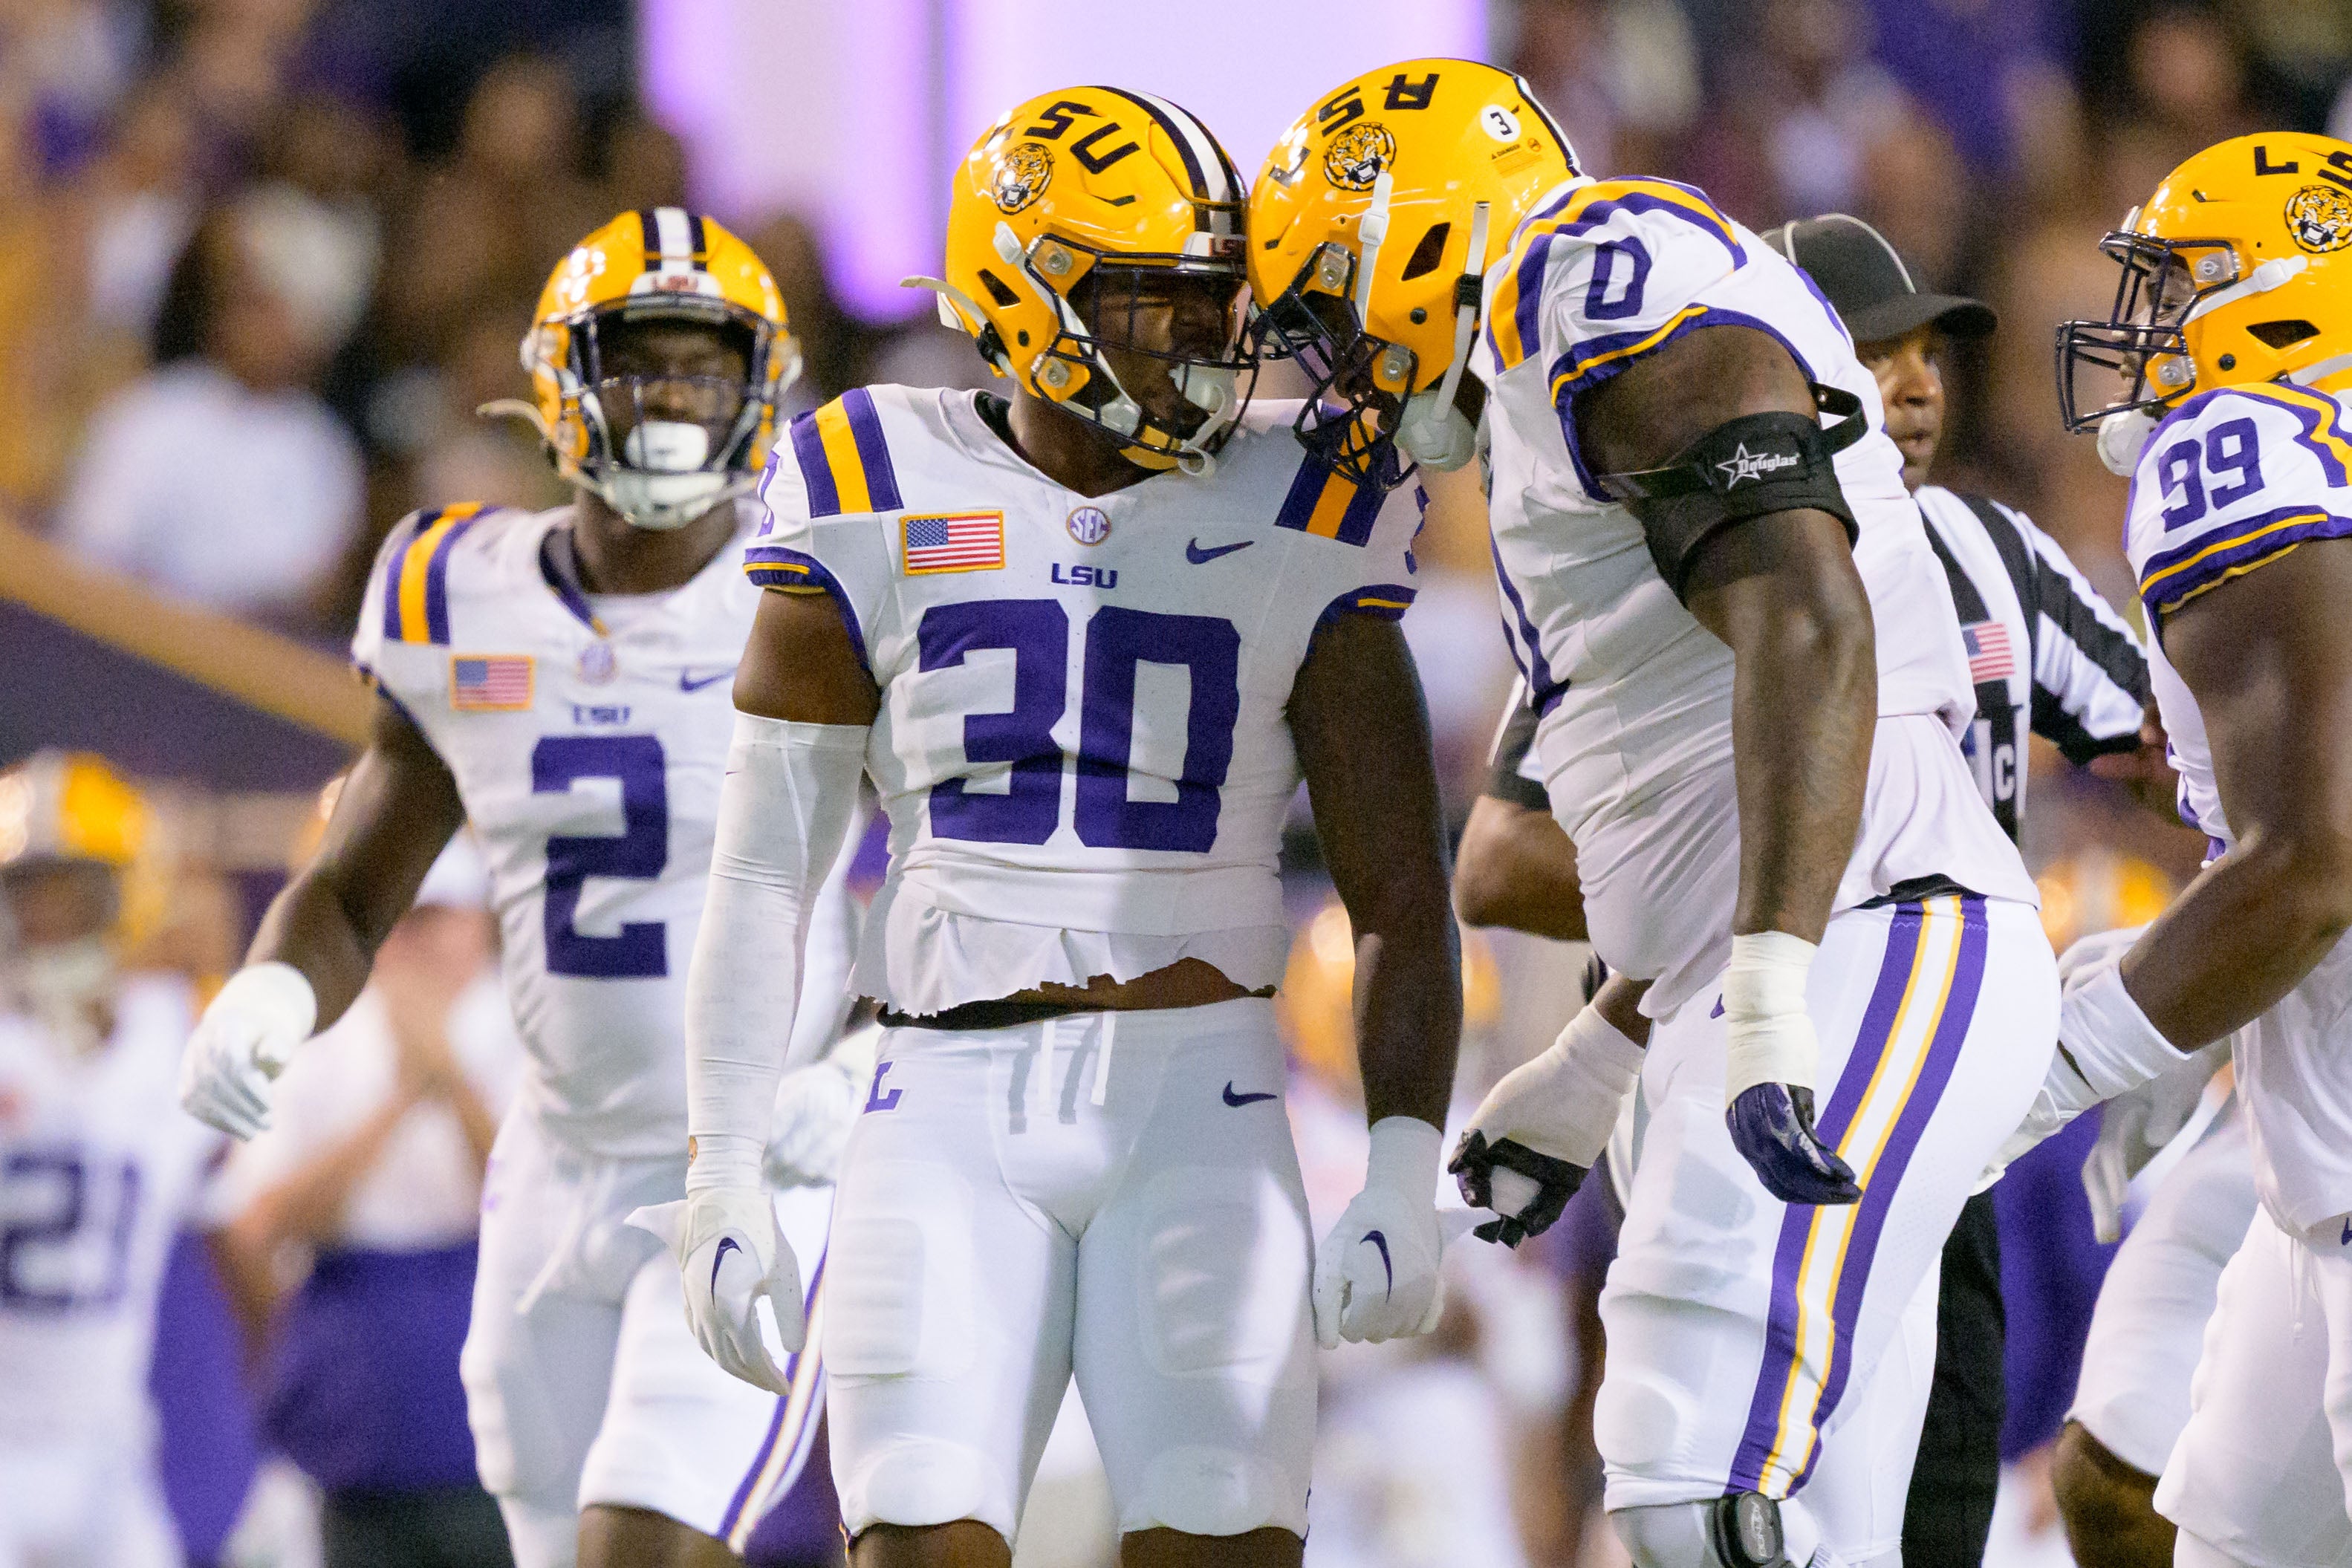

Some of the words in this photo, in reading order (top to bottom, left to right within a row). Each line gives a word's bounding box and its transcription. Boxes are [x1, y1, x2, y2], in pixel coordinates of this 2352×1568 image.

[1490, 111, 1513, 136] 3
[1738, 452, 1798, 474] Douglas
[2158, 417, 2266, 533] 99
[1069, 508, 1110, 544] SEC
[1051, 562, 1119, 589] LSU
[917, 599, 1241, 853] 30
[531, 734, 669, 979] 2
[862, 1060, 904, 1115] L
